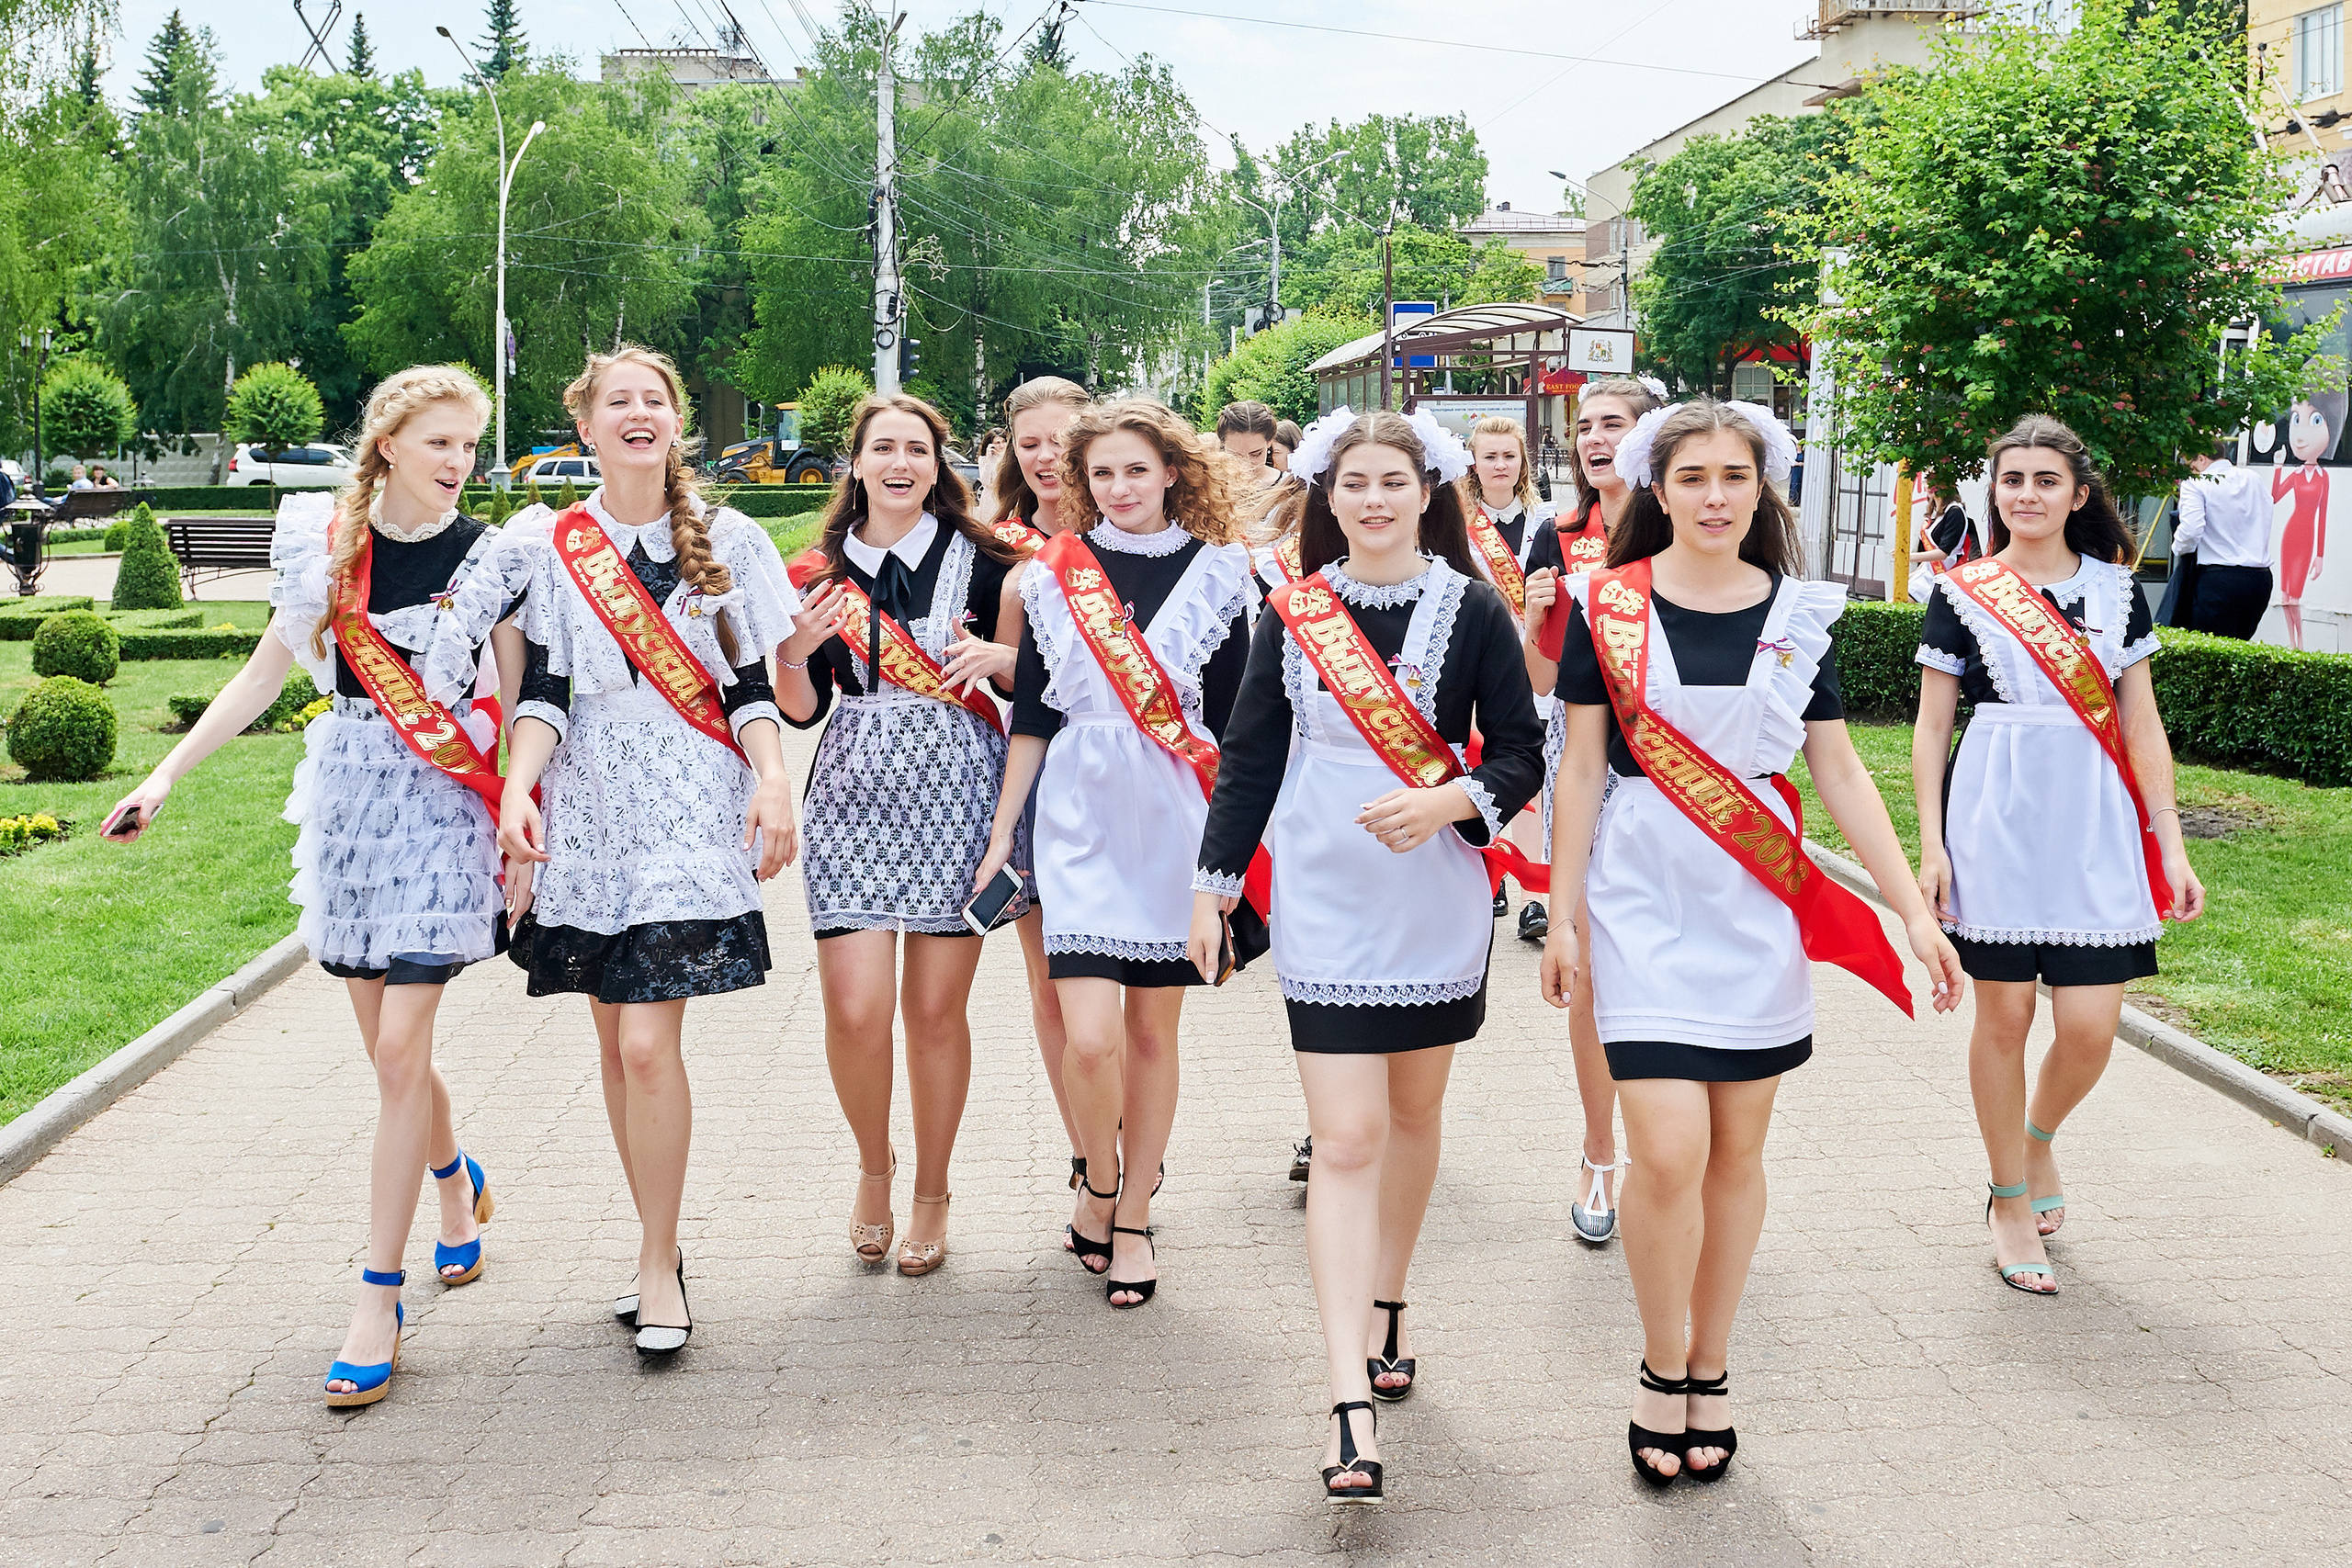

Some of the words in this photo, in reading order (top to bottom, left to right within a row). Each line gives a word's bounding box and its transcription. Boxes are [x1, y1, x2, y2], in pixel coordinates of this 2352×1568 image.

[1305, 612, 1449, 787] Выпускни
[412, 721, 489, 776] 201
[1731, 814, 1810, 896] 2018
